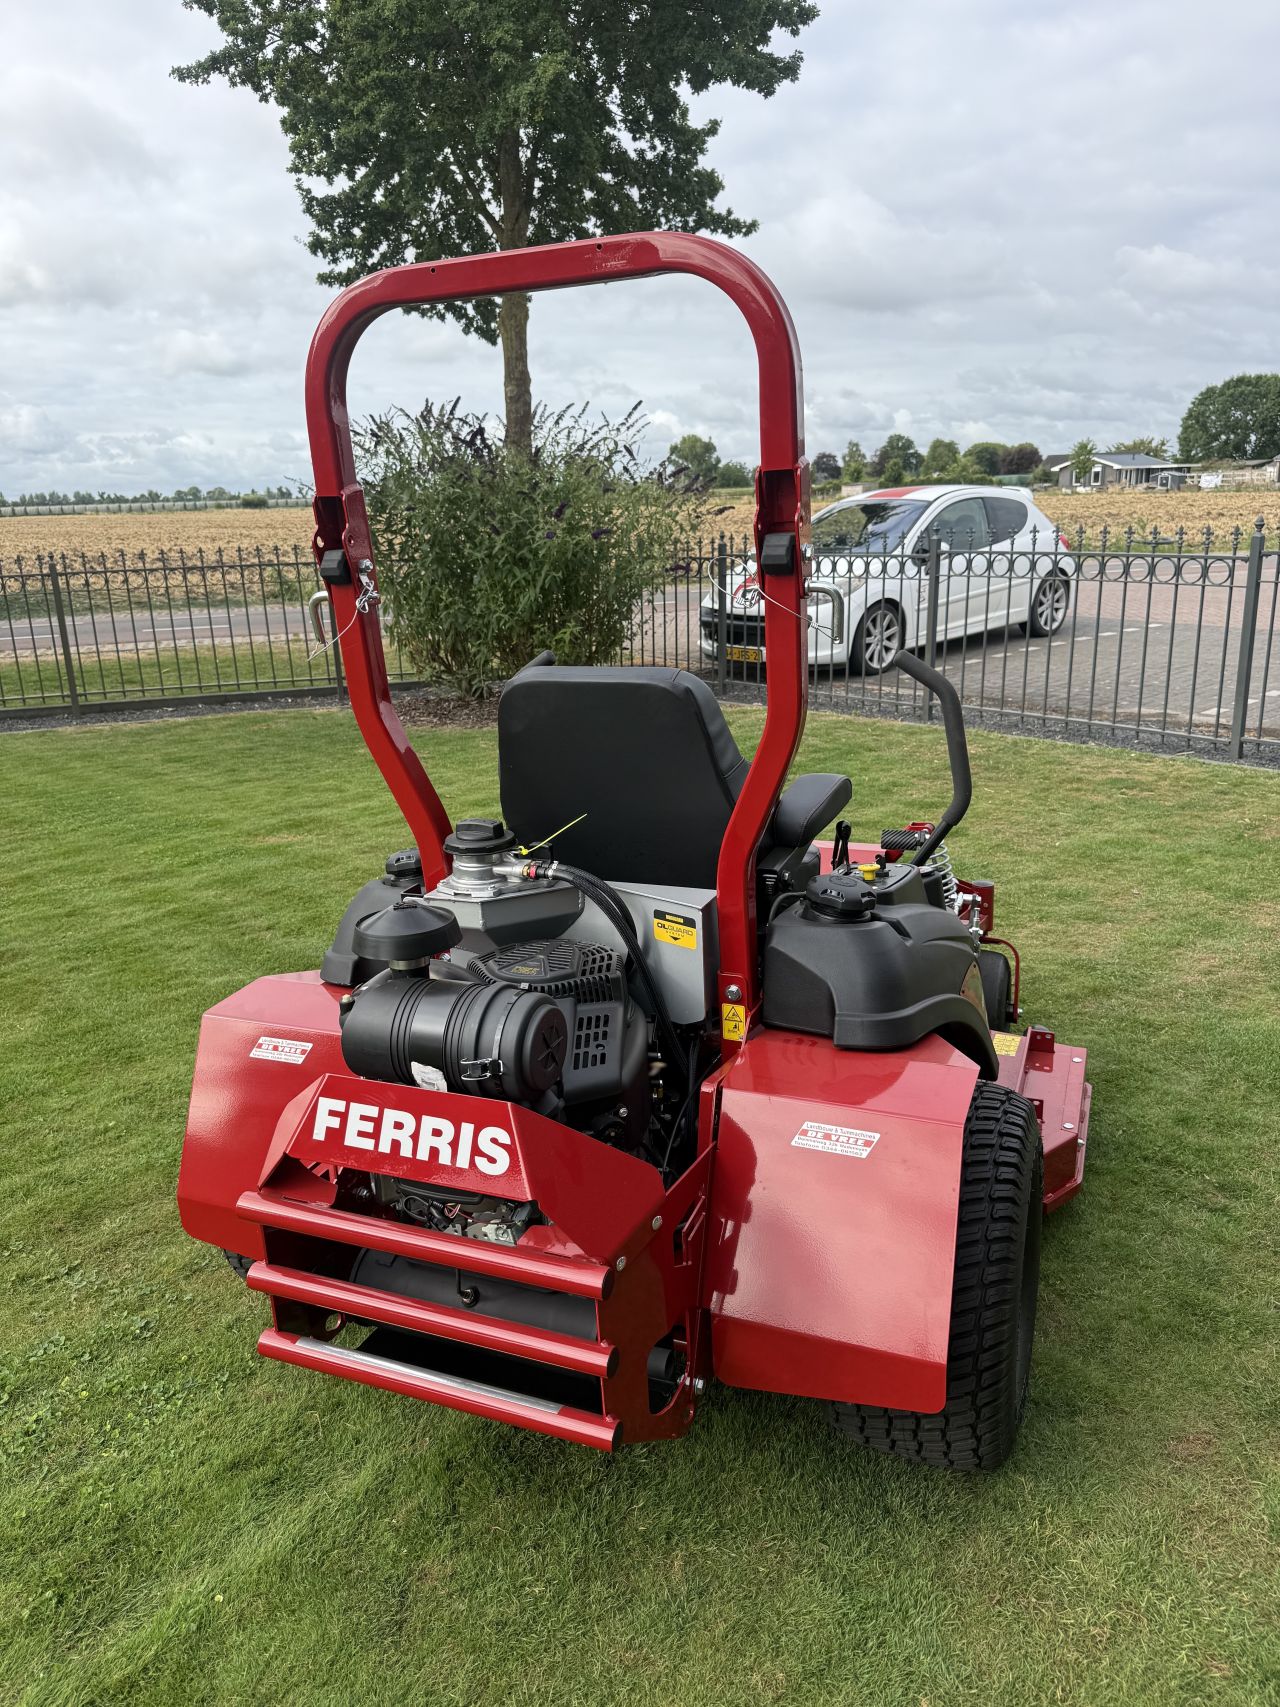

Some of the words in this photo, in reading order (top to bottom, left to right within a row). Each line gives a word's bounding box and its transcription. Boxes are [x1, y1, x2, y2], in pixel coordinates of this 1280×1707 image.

[312, 1097, 511, 1175] FERRIS
[806, 1130, 825, 1139] DE
[831, 1134, 866, 1146] VREE
